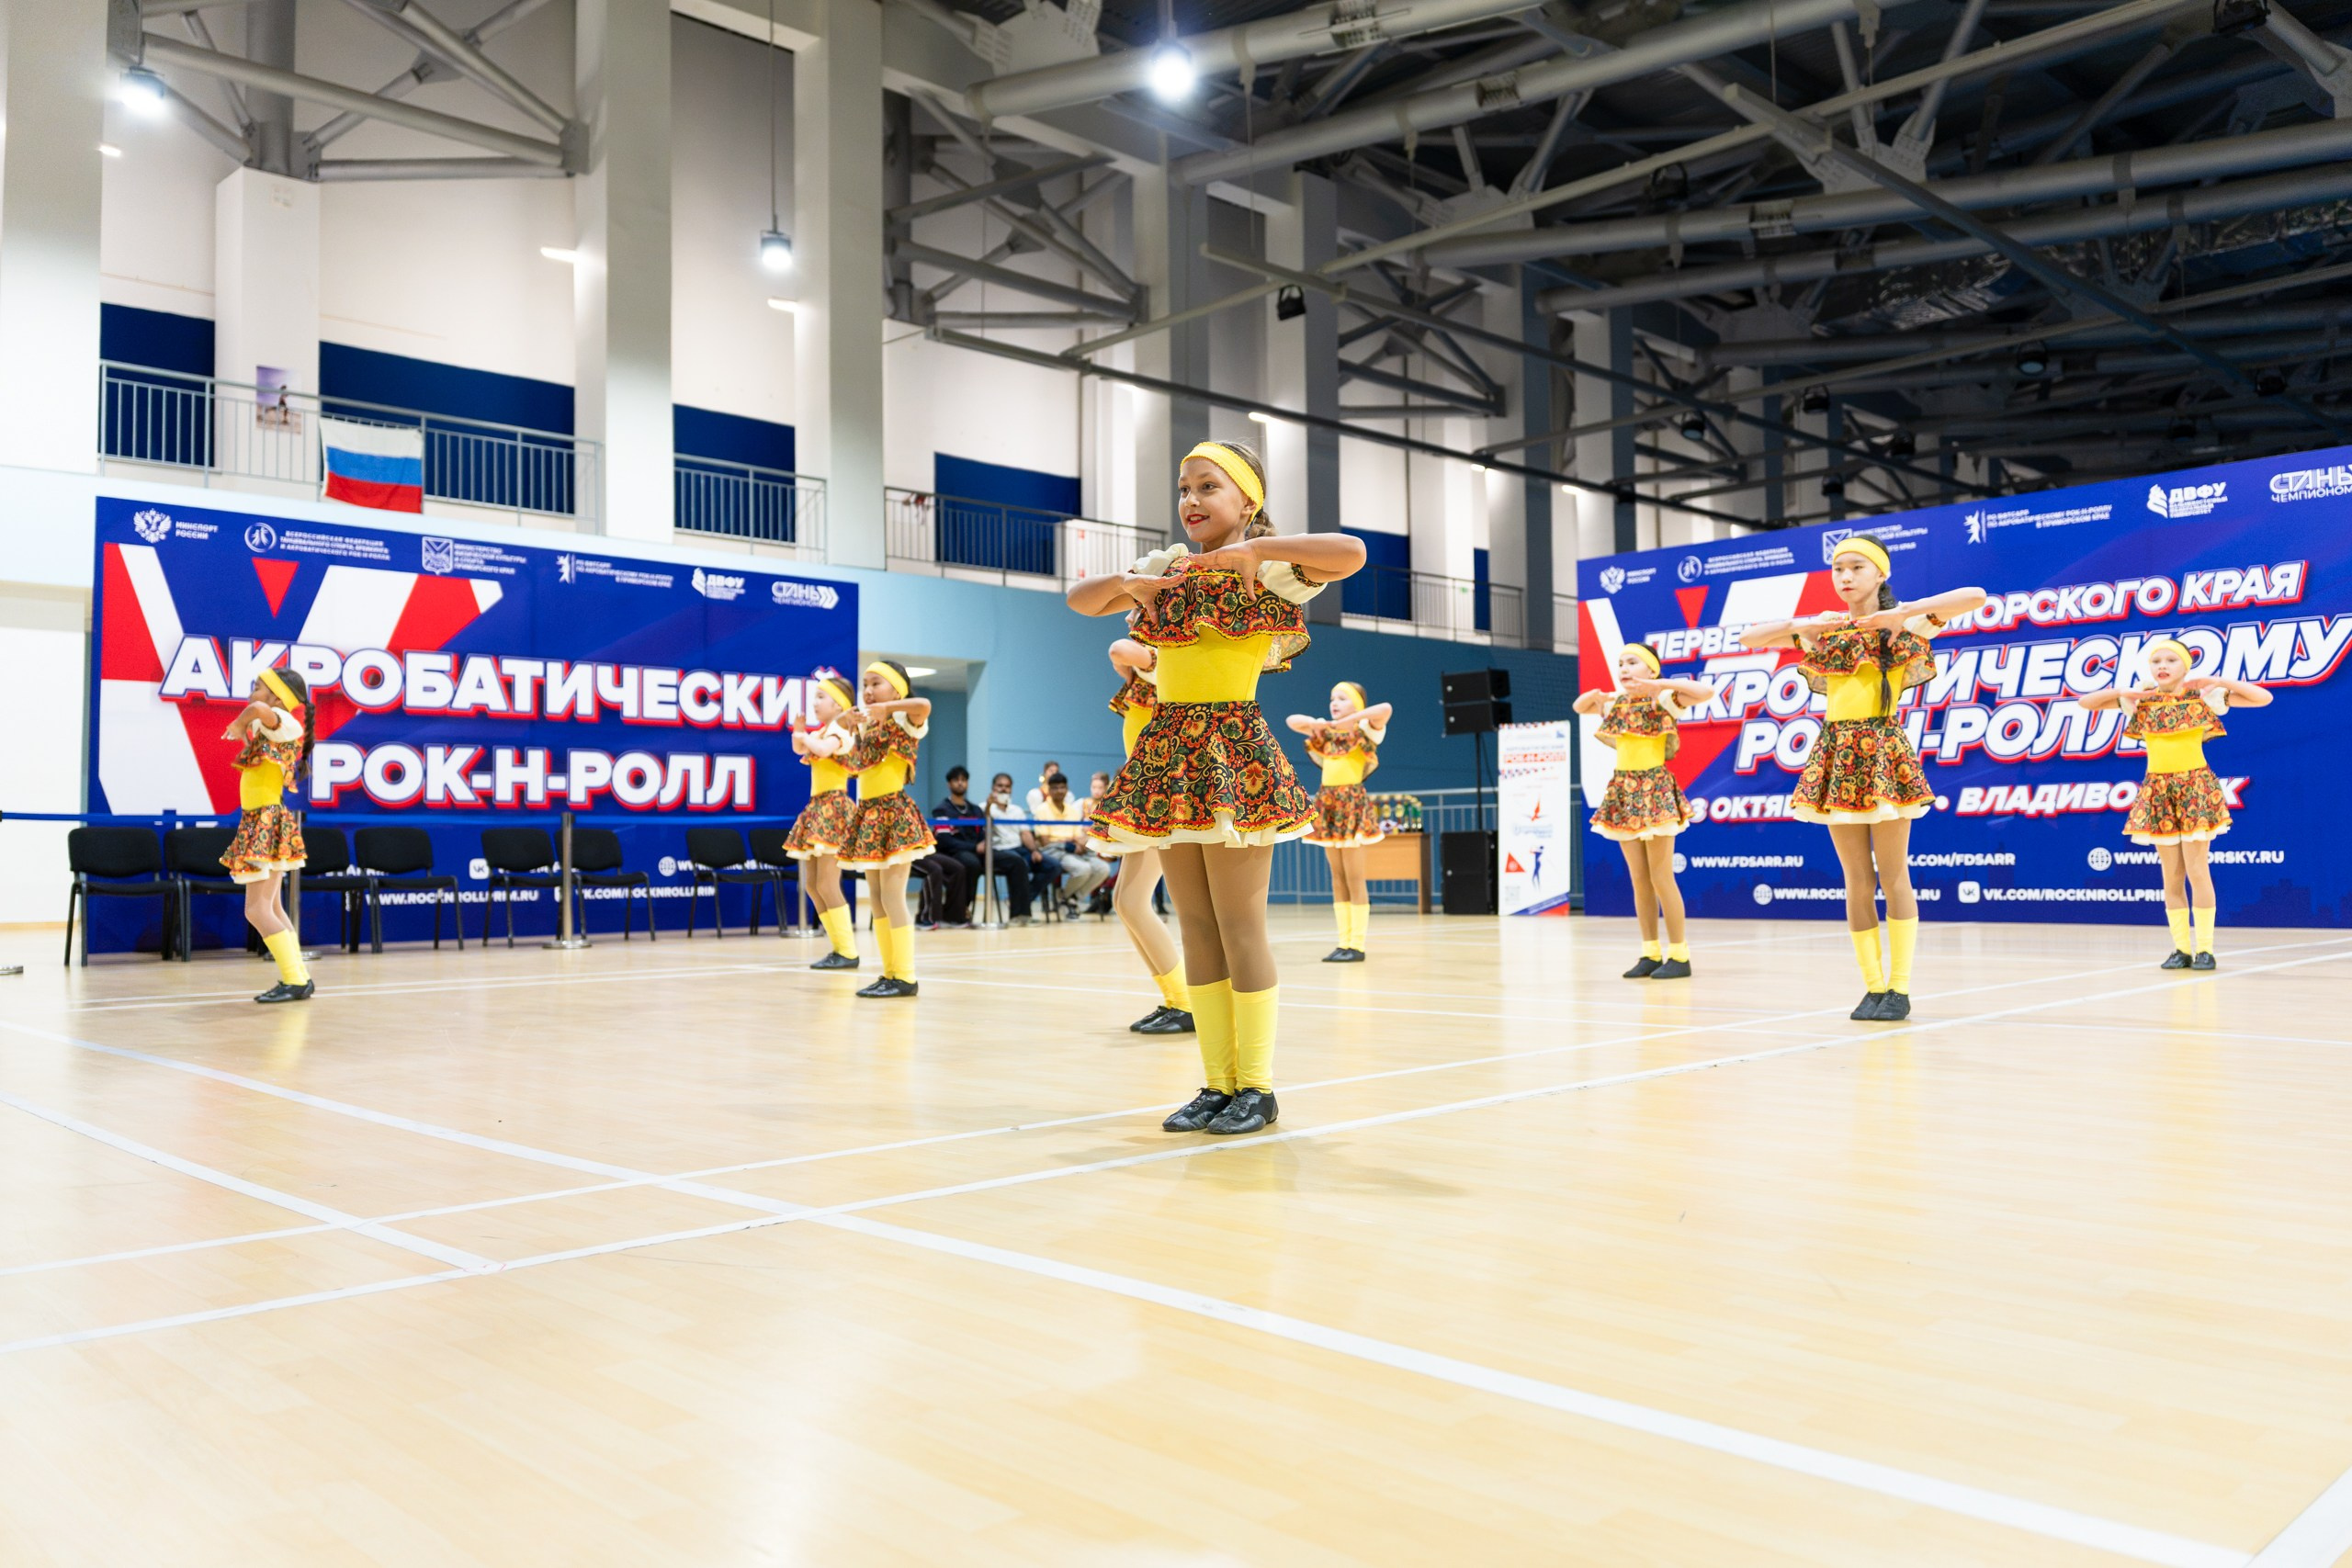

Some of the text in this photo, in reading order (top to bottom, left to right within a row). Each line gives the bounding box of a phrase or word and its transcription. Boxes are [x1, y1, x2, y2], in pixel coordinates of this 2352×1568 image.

[2269, 465, 2352, 493] СТАНЬ
[2169, 482, 2226, 503] ДВФУ
[2271, 485, 2352, 503] ЧЕМПИОНОМ
[707, 574, 745, 588] ДВФУ
[772, 581, 820, 598] СТАНЬ
[1940, 574, 2176, 633] ОРСКОГО
[2178, 560, 2306, 611] КРАЯ
[1670, 613, 2352, 723] КРОИЧЕСКОМУ
[1736, 697, 2148, 772] РО-РОЛЛ
[309, 739, 753, 809] РОК-Н-РОЛЛ
[1710, 794, 1794, 822] ОКТЯ
[1957, 776, 2249, 816] ВЛАДИВОК
[1691, 855, 1804, 868] WWW.FDSARR.RU
[1907, 852, 2016, 867] K.COM/FDSARR
[2113, 852, 2285, 864] WWW.ORSKY.RU
[1774, 888, 1941, 901] WWW.ROCKL.RU
[1983, 887, 2165, 903] VK.COM/ROCKNROLLPRI
